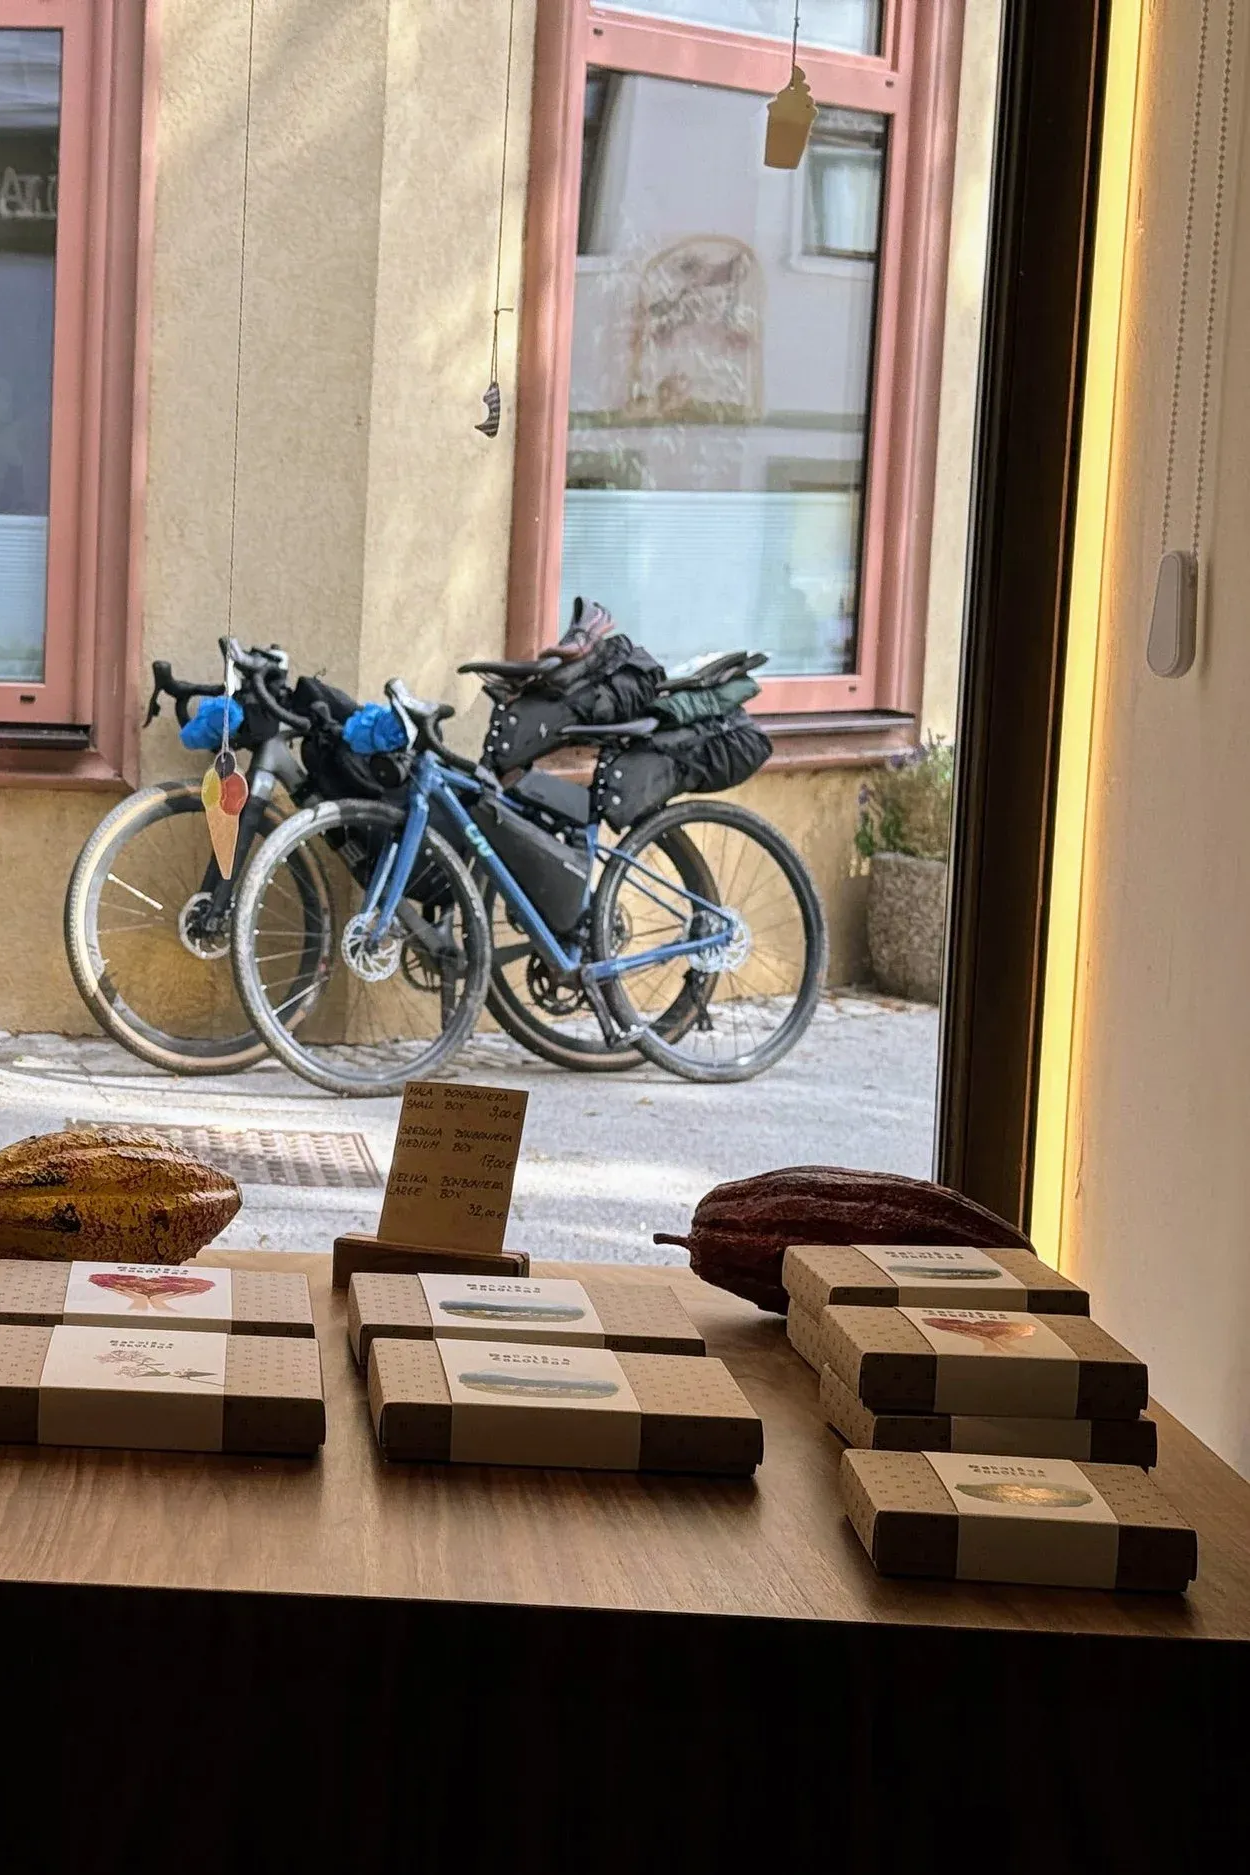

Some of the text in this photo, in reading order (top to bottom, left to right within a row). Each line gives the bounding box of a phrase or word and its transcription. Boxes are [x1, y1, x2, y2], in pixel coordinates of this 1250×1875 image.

[405, 1099, 435, 1110] SMALL
[444, 1101, 467, 1111] BOX
[398, 1138, 474, 1153] MEDIUM BOX
[390, 1172, 428, 1184] VELIKA
[388, 1185, 464, 1199] LARGE BOX
